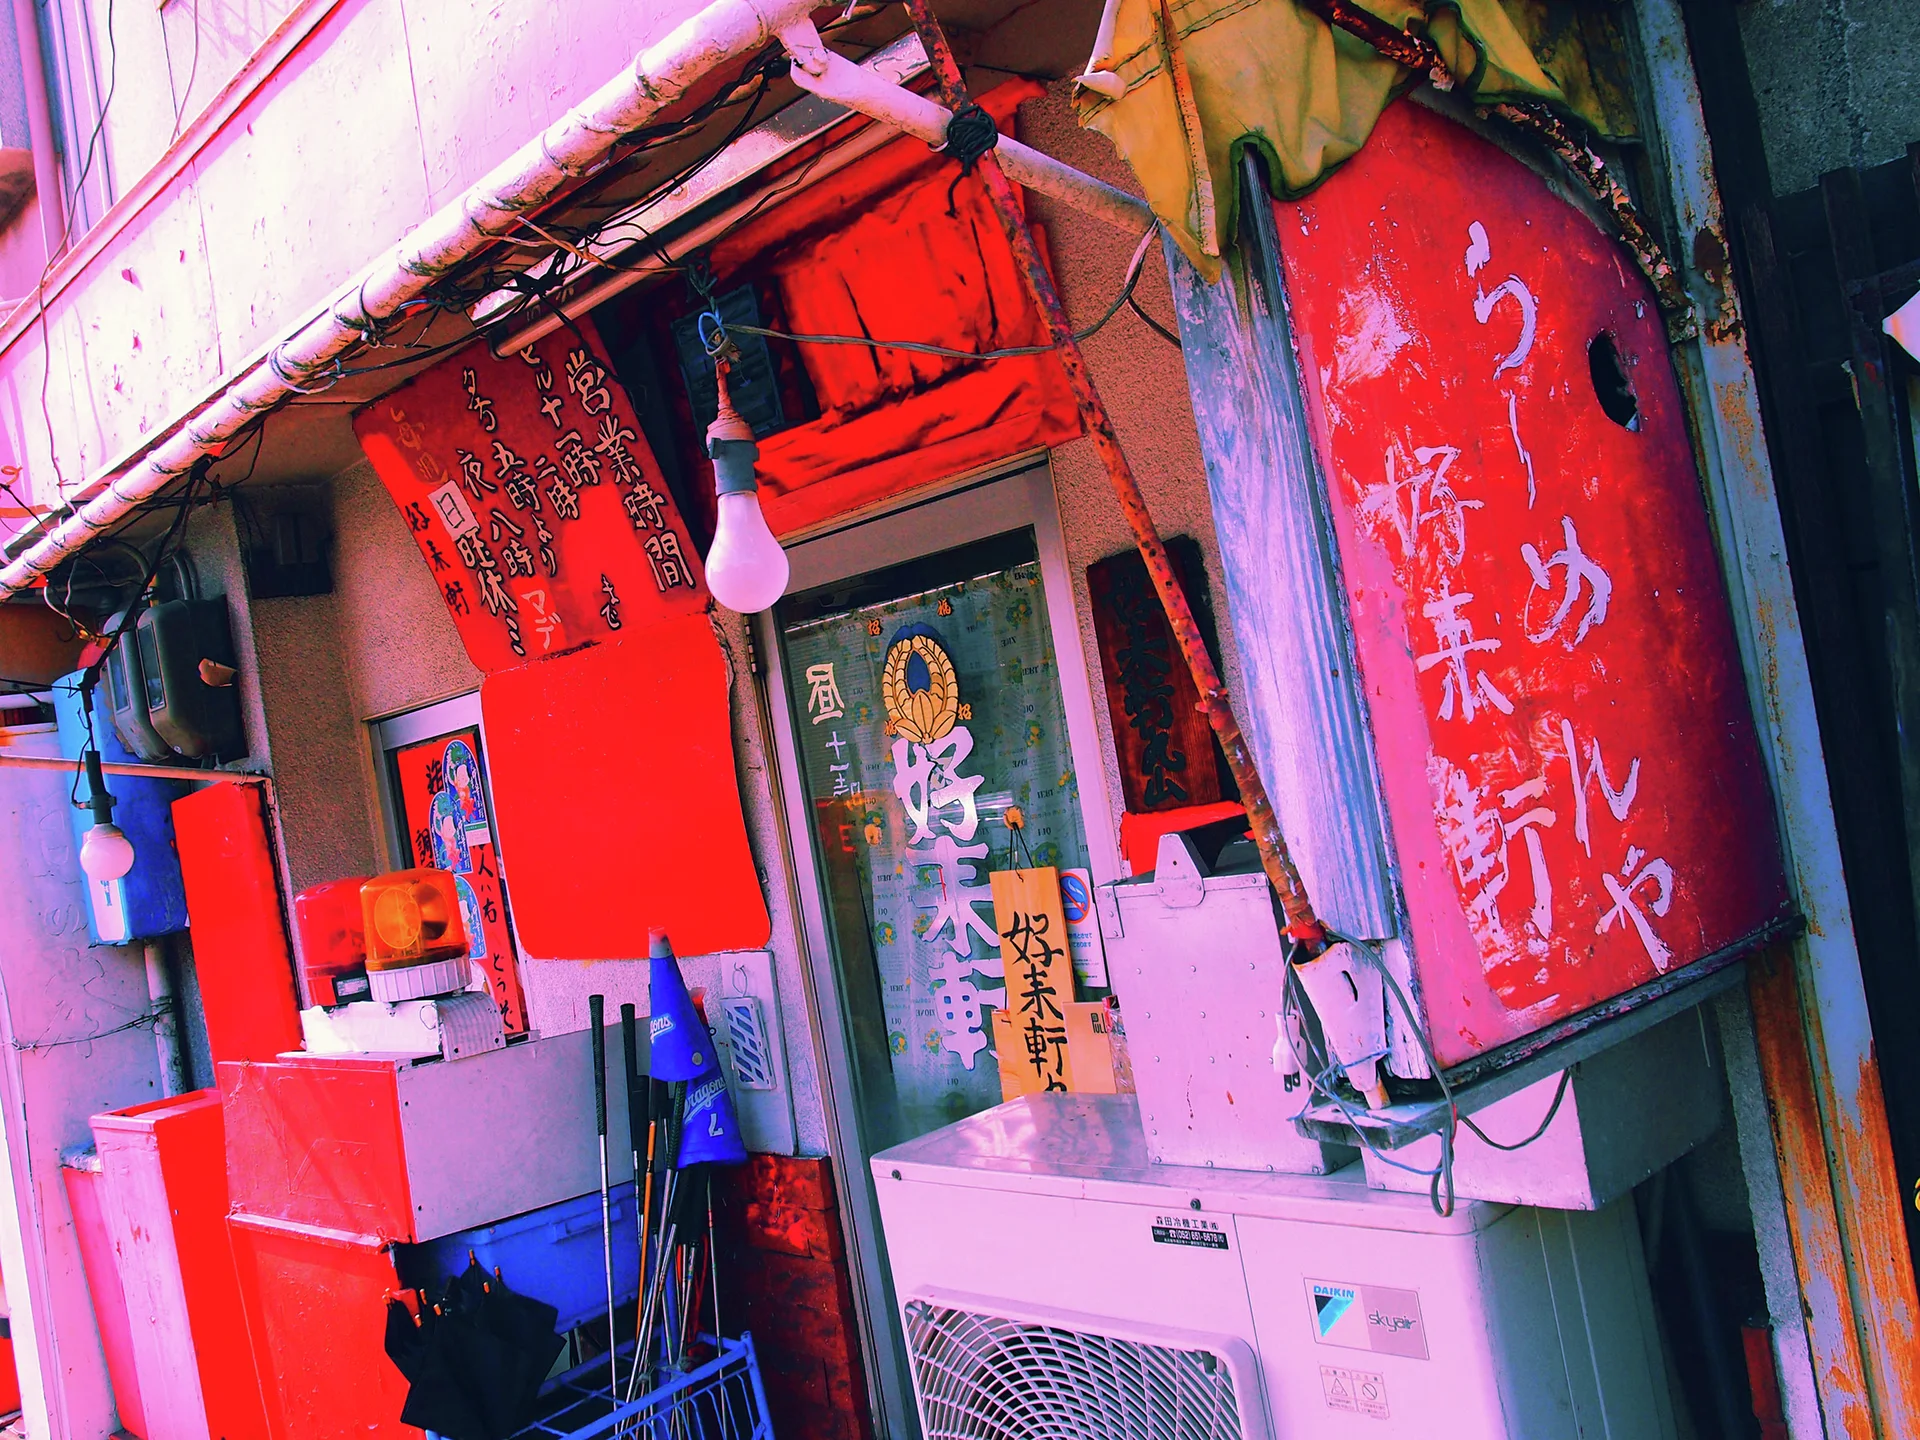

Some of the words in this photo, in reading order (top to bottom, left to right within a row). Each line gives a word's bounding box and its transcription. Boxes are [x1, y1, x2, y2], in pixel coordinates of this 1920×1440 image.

[565, 349, 696, 593] 営業時間
[1465, 220, 1675, 976] らーめんや
[1313, 1285, 1355, 1299] DAIKIN
